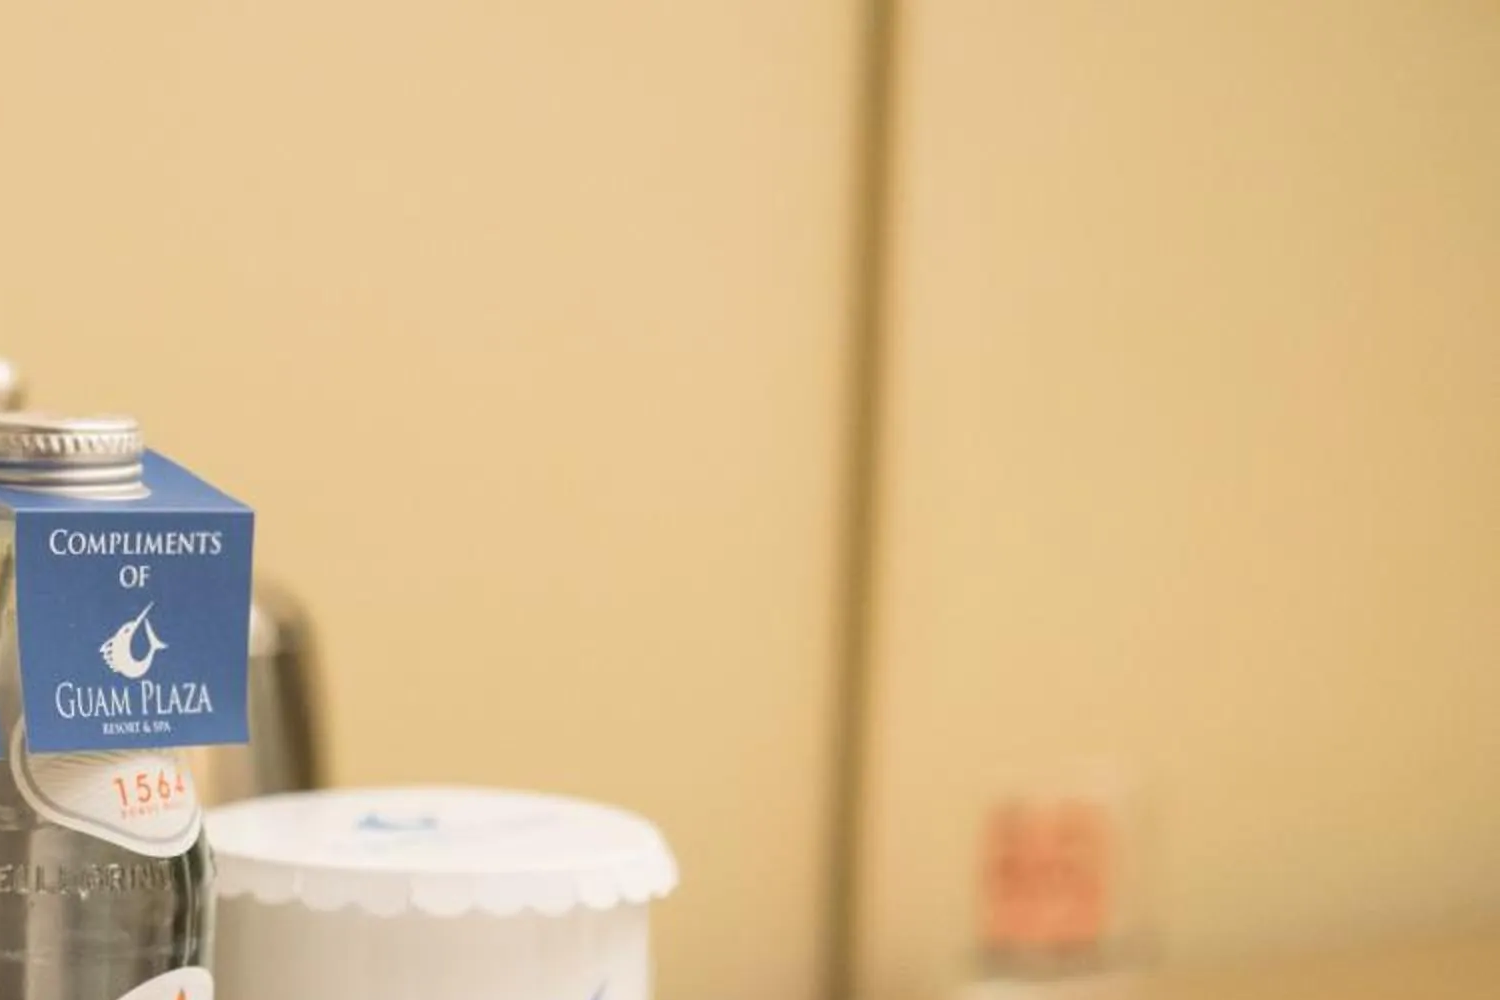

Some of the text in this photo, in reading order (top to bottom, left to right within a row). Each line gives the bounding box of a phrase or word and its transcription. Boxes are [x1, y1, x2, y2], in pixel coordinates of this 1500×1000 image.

[49, 528, 222, 556] COMPLIMENTS
[119, 565, 150, 589] OF
[55, 680, 213, 719] GUAM PLAZA
[103, 721, 140, 735] RESORT
[153, 720, 171, 733] SPA
[112, 769, 185, 807] 1564
